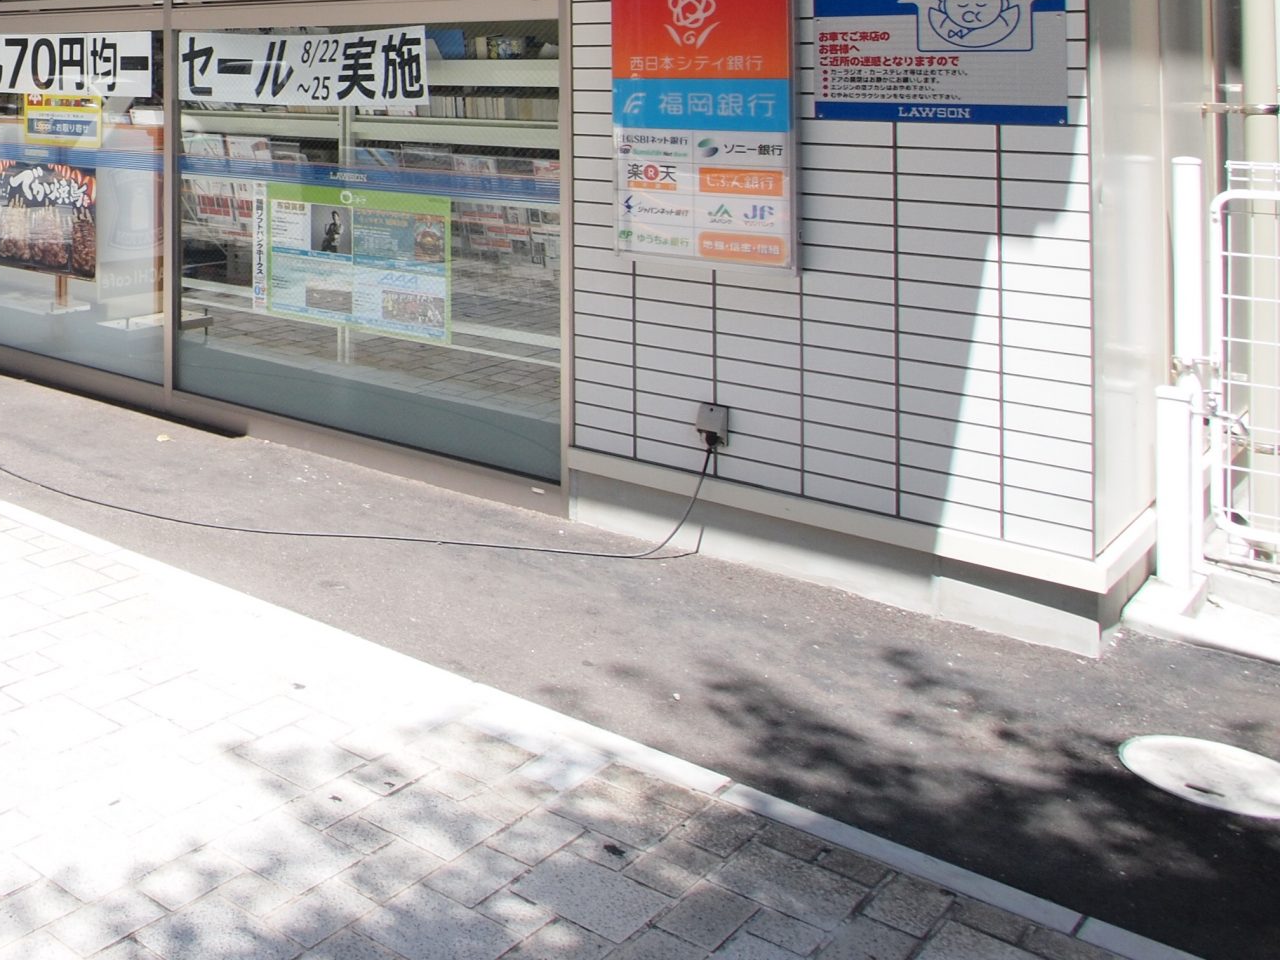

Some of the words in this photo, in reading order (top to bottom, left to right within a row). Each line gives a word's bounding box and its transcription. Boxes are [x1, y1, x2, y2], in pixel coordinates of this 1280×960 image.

[818, 31, 890, 42] お車でご来店の
[818, 44, 860, 54] お客様へ
[182, 37, 294, 98] セール
[301, 39, 339, 68] 8/22
[337, 32, 424, 100] 実施
[630, 55, 763, 72] 西日本シティ銀行
[819, 56, 959, 67] ご近所の迷惑となりますので
[658, 92, 776, 117] 福岡銀行
[898, 106, 970, 118] LAWSON
[724, 143, 783, 156] ソニー銀行
